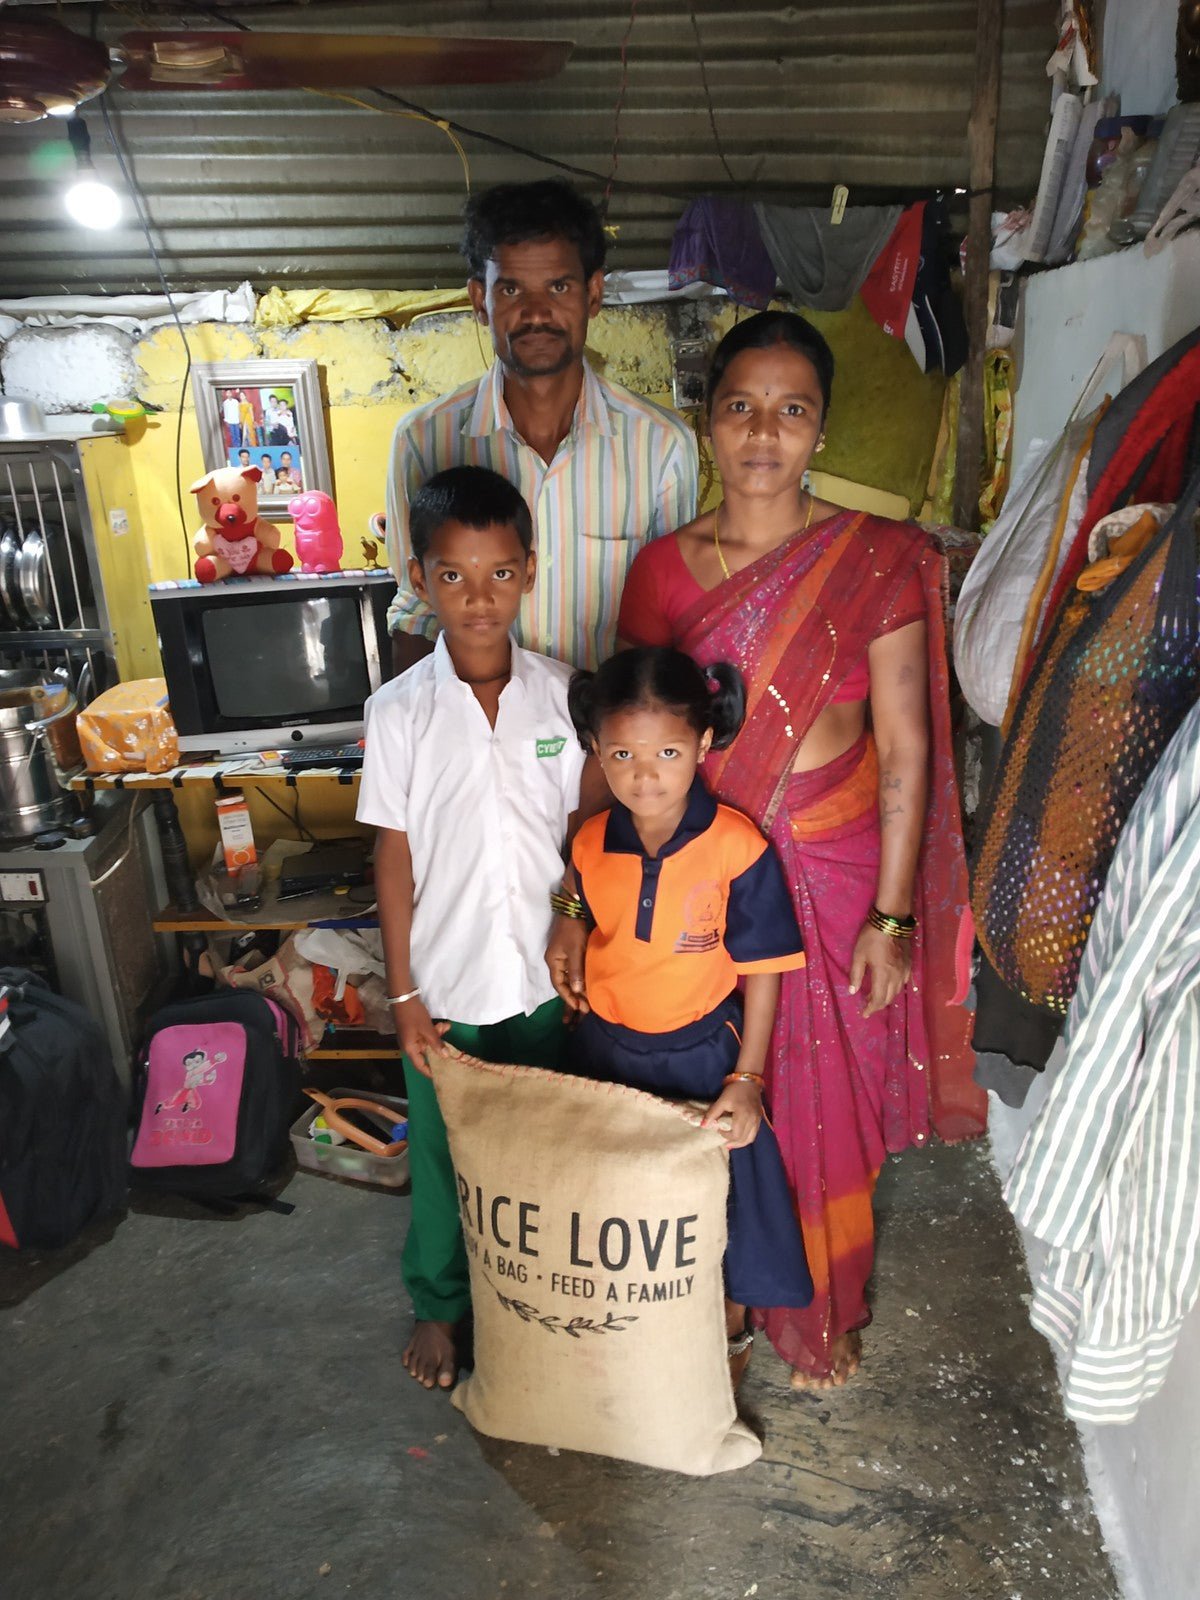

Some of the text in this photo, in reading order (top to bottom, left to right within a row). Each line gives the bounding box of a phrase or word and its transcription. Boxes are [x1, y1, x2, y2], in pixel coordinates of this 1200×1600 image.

[458, 1172, 540, 1257] RICE
[570, 1212, 698, 1271] LOVE
[484, 1248, 695, 1303] A BAG FEED A FAMILY
